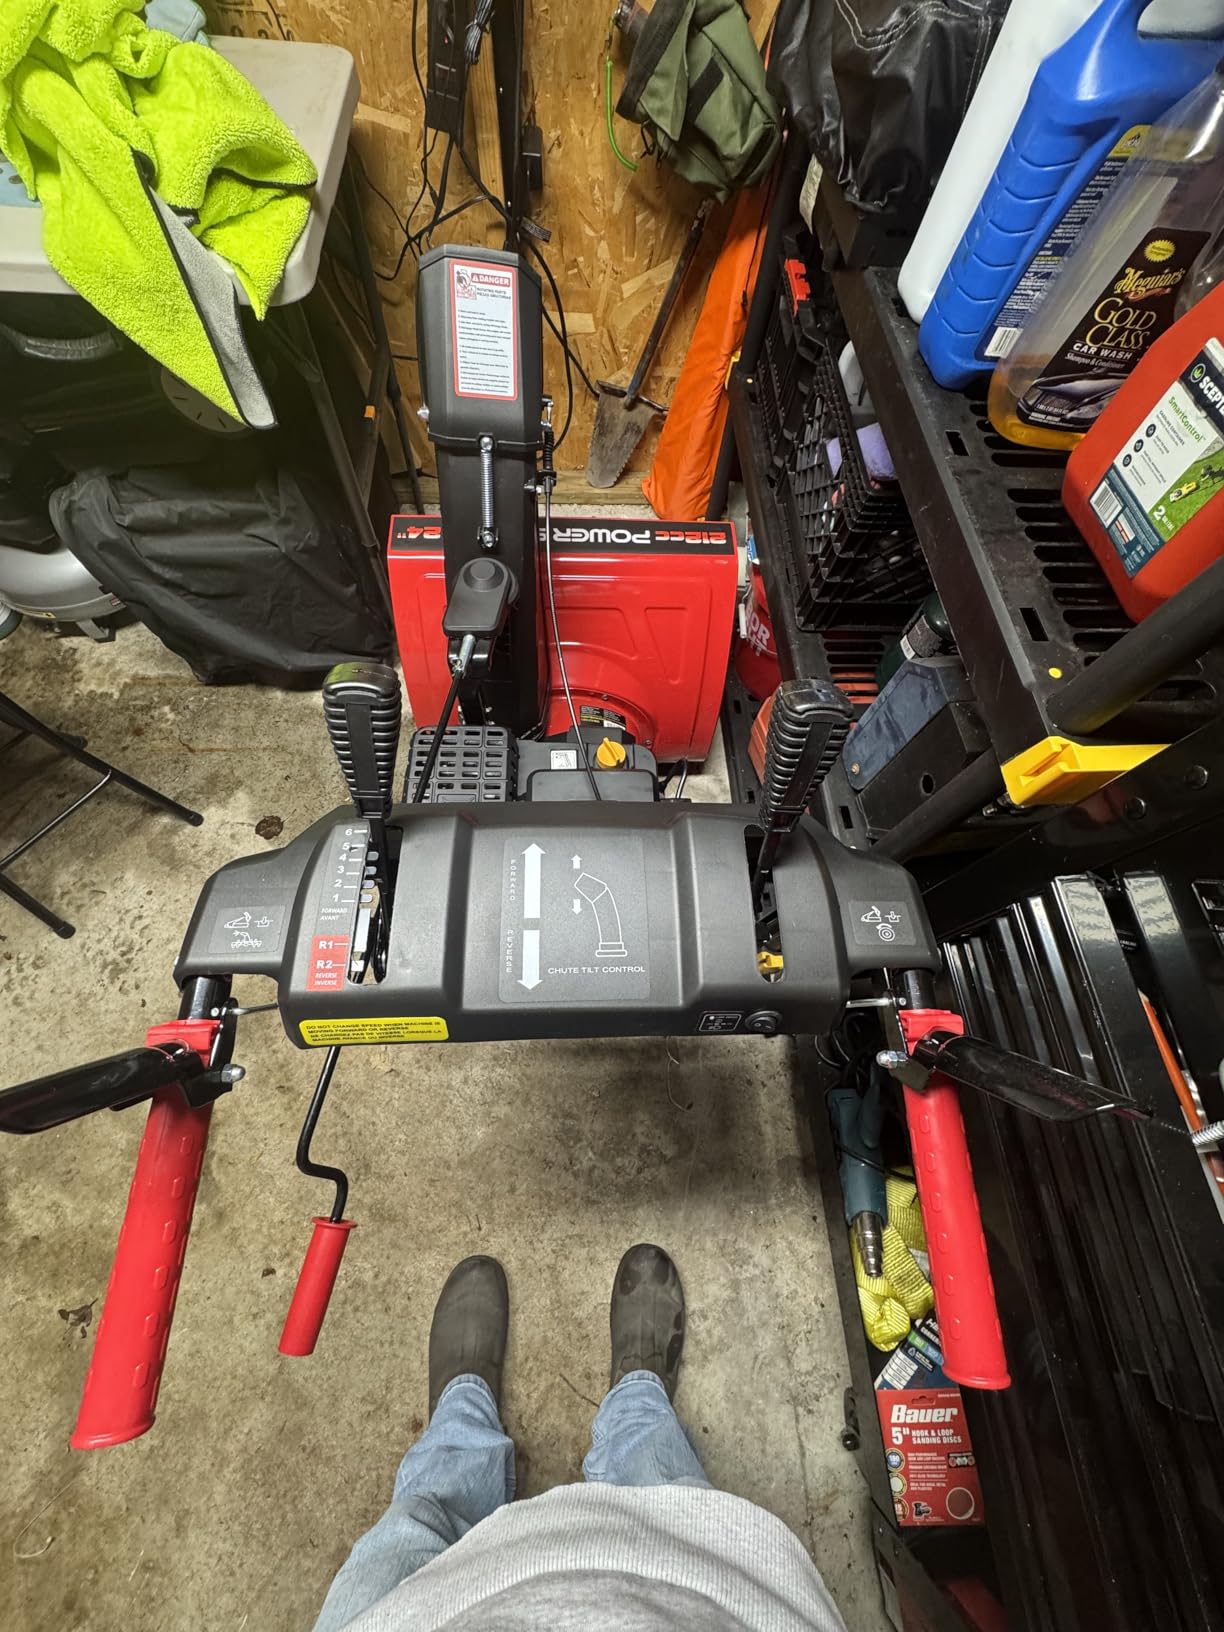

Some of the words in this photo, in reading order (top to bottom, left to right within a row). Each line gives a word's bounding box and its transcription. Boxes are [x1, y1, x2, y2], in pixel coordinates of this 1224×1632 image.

[479, 275, 510, 286] DANGER
[1114, 267, 1185, 297] Meguiar's
[1094, 297, 1157, 331] GOLD
[1085, 324, 1151, 350] CLASS
[1072, 342, 1099, 354] CAR
[1100, 348, 1132, 360] WASH
[1065, 352, 1091, 366] Shampoo
[1152, 504, 1167, 521] 2
[396, 526, 441, 540] 24"
[552, 528, 651, 544] POWER
[655, 530, 727, 545] 212cc
[346, 828, 352, 836] 6
[342, 842, 350, 850] 5
[338, 853, 347, 862] 4
[337, 866, 344, 874] 3
[334, 880, 342, 888] 2
[510, 859, 518, 901] FORWARD
[332, 894, 339, 902] 1
[318, 940, 334, 950] R1
[506, 930, 514, 973] REVERSE
[316, 960, 333, 969] R2
[582, 966, 600, 974] TILT
[602, 966, 646, 974] CONTROL
[890, 1404, 958, 1424] Bauer
[892, 1427, 910, 1445] 5"
[938, 1428, 954, 1436] LOOP
[912, 1437, 942, 1445] SANDING
[943, 1436, 962, 1444] DISCS
